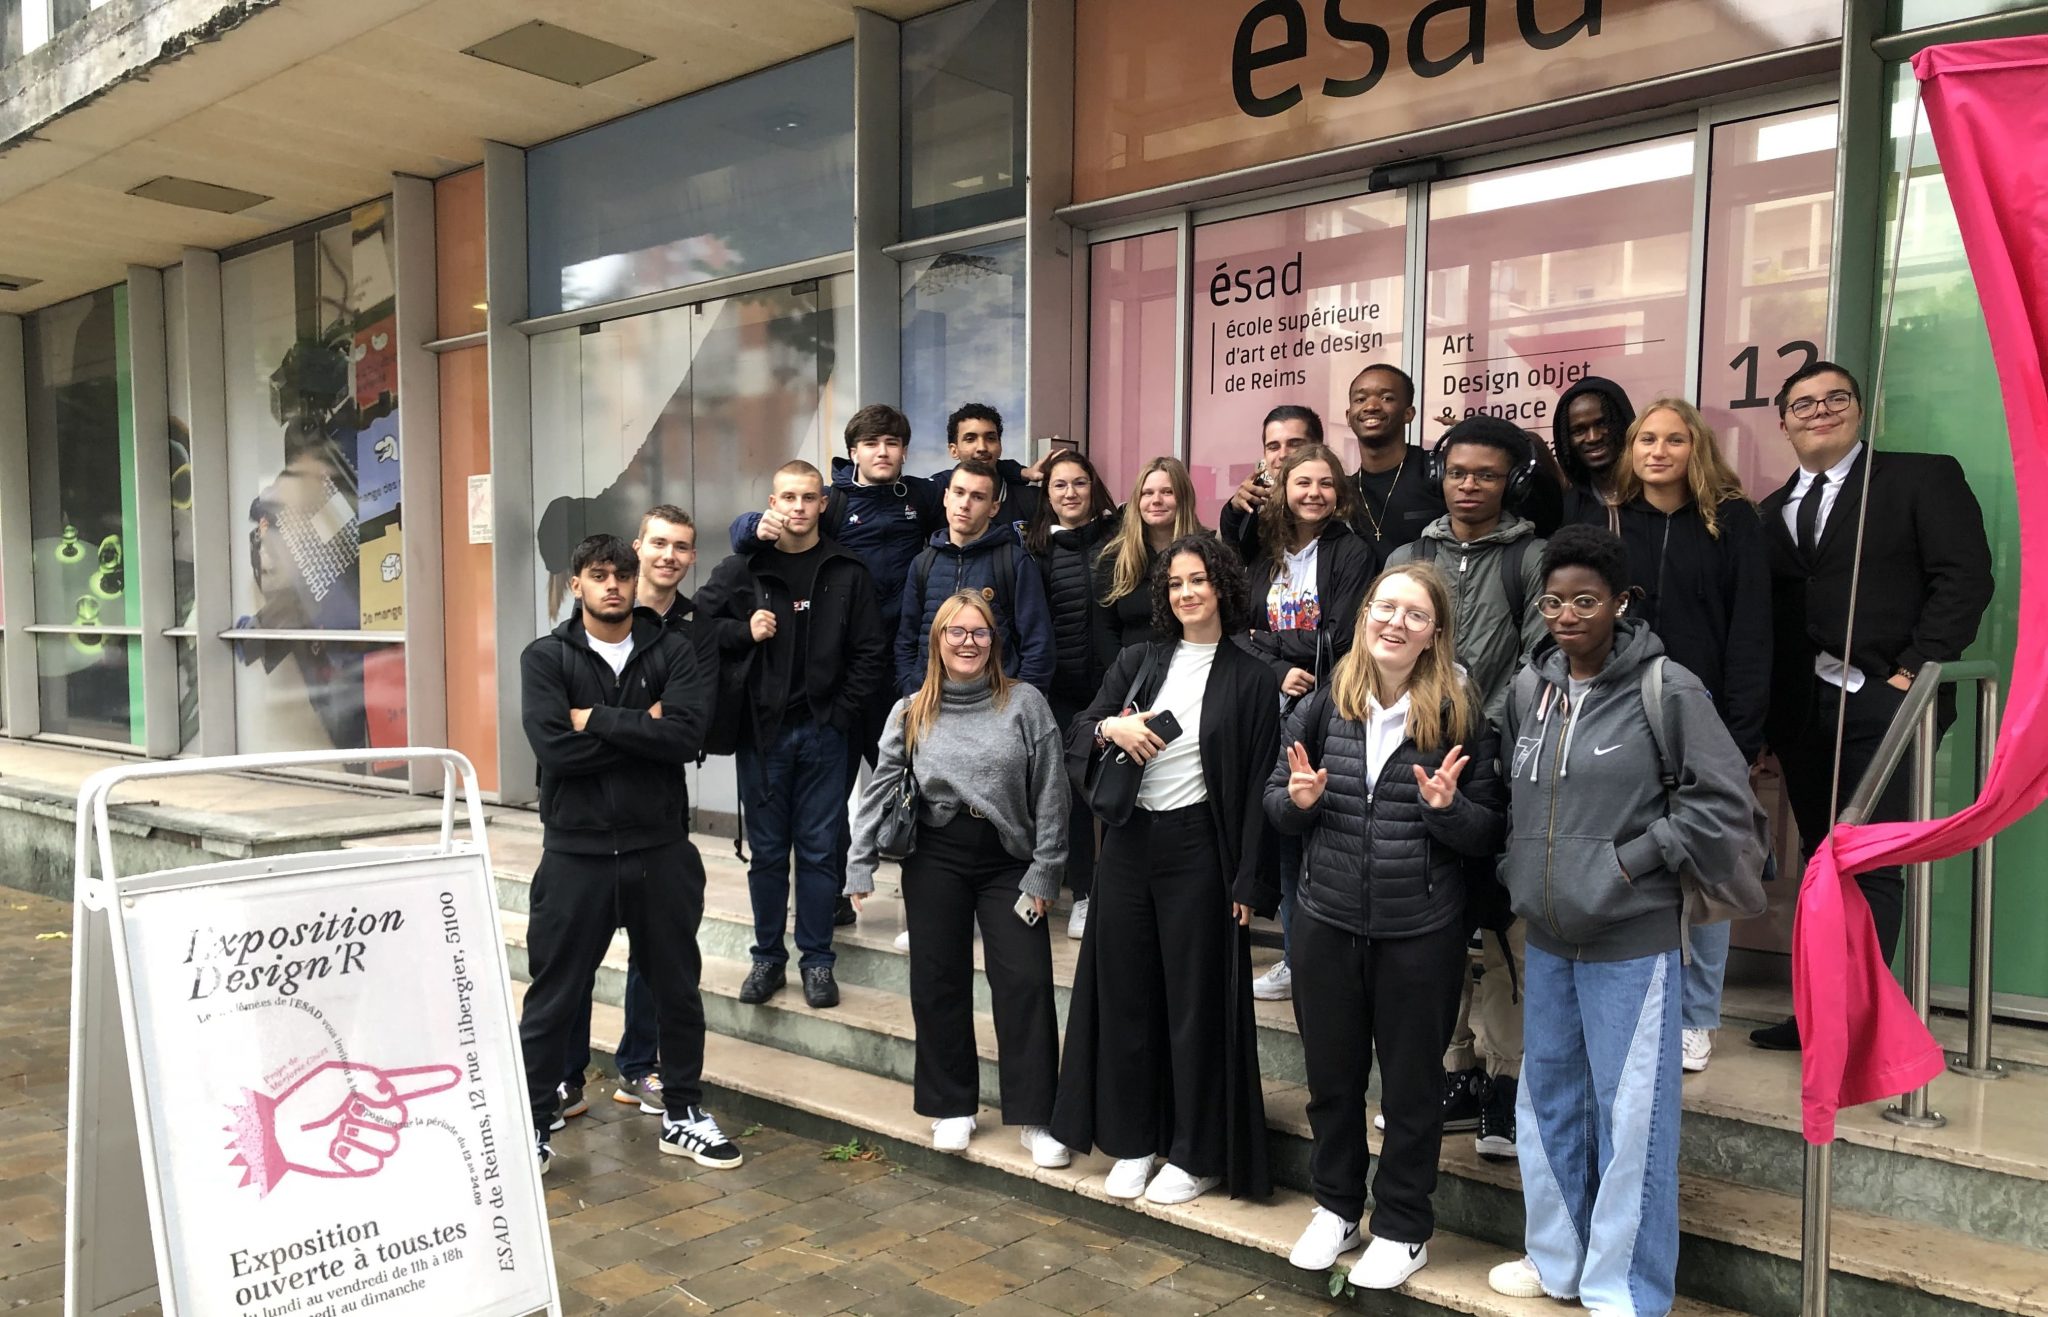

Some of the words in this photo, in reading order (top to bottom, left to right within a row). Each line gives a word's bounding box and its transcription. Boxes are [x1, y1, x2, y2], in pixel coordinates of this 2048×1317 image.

[1209, 251, 1303, 307] ésad
[1226, 316, 1273, 339] école
[1278, 303, 1380, 333] supérieure
[1225, 345, 1265, 366] d'art
[1270, 342, 1288, 360] et
[1293, 338, 1315, 358] de
[1320, 331, 1383, 354] design
[1442, 333, 1475, 355] Art
[1225, 374, 1246, 393] de
[1251, 368, 1306, 391] Reims
[1443, 369, 1519, 396] Design
[1527, 361, 1591, 390] objet
[1729, 340, 1819, 409] 12
[1442, 406, 1457, 419] &
[1463, 400, 1547, 421] espace
[440, 891, 461, 943] 51100
[188, 941, 367, 1000] Design'R
[452, 949, 476, 1047] Libergier,
[466, 1051, 482, 1083] rue
[469, 1089, 487, 1110] 12
[426, 1116, 458, 1136] période
[479, 1114, 501, 1181] Reims,
[489, 1185, 504, 1208] de
[230, 1220, 381, 1278] Exposition
[493, 1215, 515, 1272] ESAD
[236, 1258, 345, 1306] ouverte
[354, 1248, 369, 1270] à
[376, 1222, 467, 1263] tous.tes
[263, 1297, 301, 1317] lundi
[306, 1293, 323, 1307] au
[327, 1270, 388, 1300] vendredi
[392, 1266, 408, 1280] de
[411, 1259, 429, 1274] 11h
[432, 1255, 441, 1268] à
[443, 1247, 464, 1264] 18h
[341, 1301, 357, 1314] au
[361, 1277, 426, 1308] dimanche
